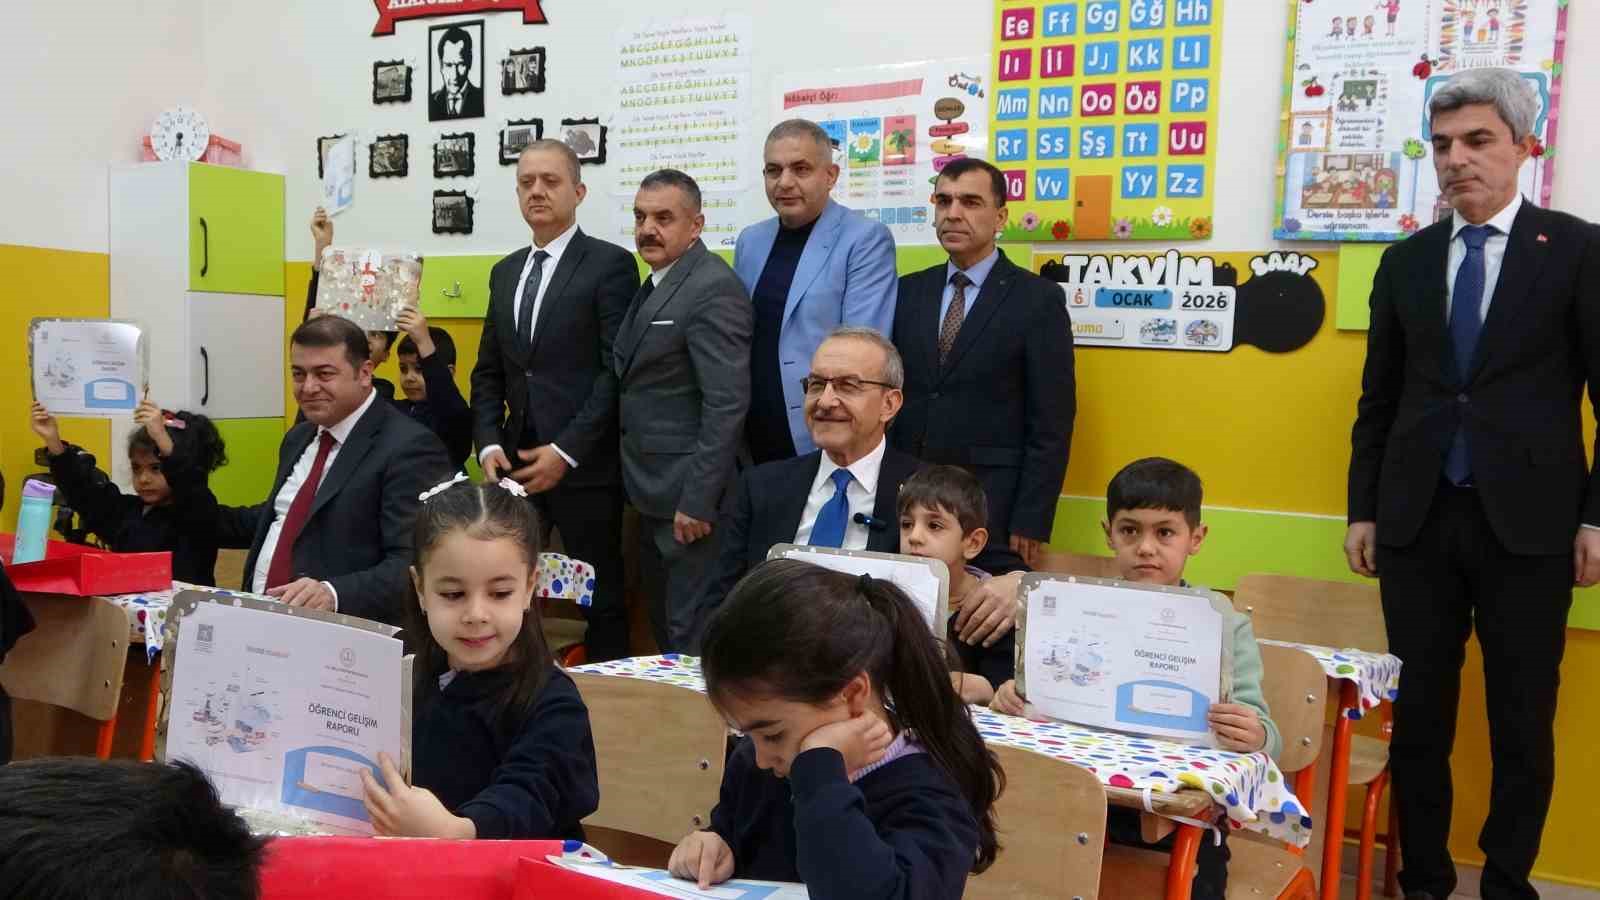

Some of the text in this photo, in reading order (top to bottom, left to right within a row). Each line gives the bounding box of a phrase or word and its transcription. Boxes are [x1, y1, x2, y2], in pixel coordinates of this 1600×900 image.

[1005, 16, 1029, 37] Ee
[1048, 11, 1070, 33] Ff
[1087, 4, 1117, 31] Gg
[1177, 1, 1208, 22] Hh
[1088, 45, 1109, 70] Jj
[1129, 43, 1160, 67] Kk
[1179, 41, 1200, 63] Ll
[997, 82, 1205, 114] Mm Nn Oo Öö Pp
[997, 128, 1204, 157] Rr Ss Şş Tt Uu
[1037, 176, 1062, 196] Vv
[1125, 171, 1152, 198] Yy
[1169, 172, 1199, 194] Zz
[1063, 250, 1214, 287] TAKVİM
[1250, 252, 1317, 276] SAAT
[1074, 289, 1227, 310] 6 OCAK 2026
[1134, 648, 1197, 666] ÖĞRENCİ GELİŞİM
[1149, 662, 1180, 673] RAPORU
[308, 702, 378, 729] ÖĞRENCİ GELİŞİM
[326, 720, 360, 737] RAPORU
